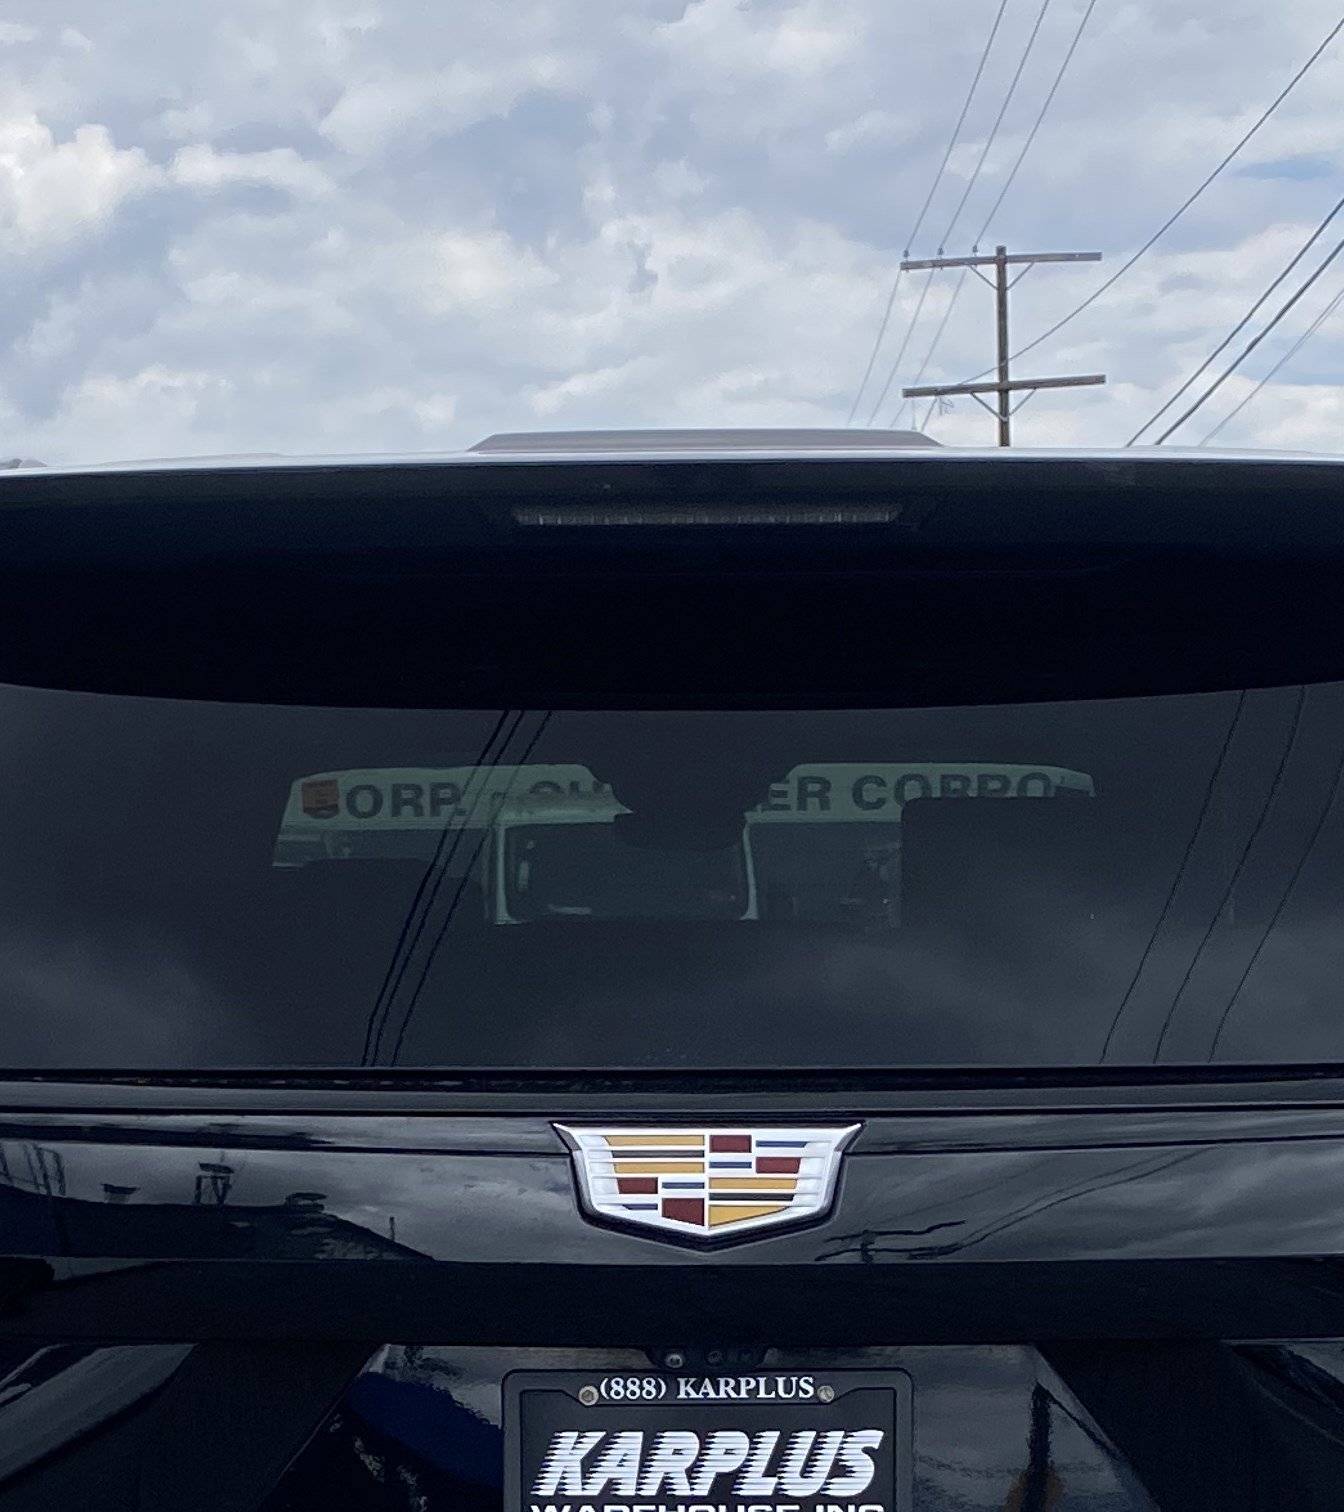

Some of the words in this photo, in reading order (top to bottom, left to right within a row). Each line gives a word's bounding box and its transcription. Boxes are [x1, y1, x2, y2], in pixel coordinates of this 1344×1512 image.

[599, 1377, 667, 1401] (888)
[676, 1376, 815, 1400] KARPLUS
[530, 1429, 885, 1498] KARPLUS
